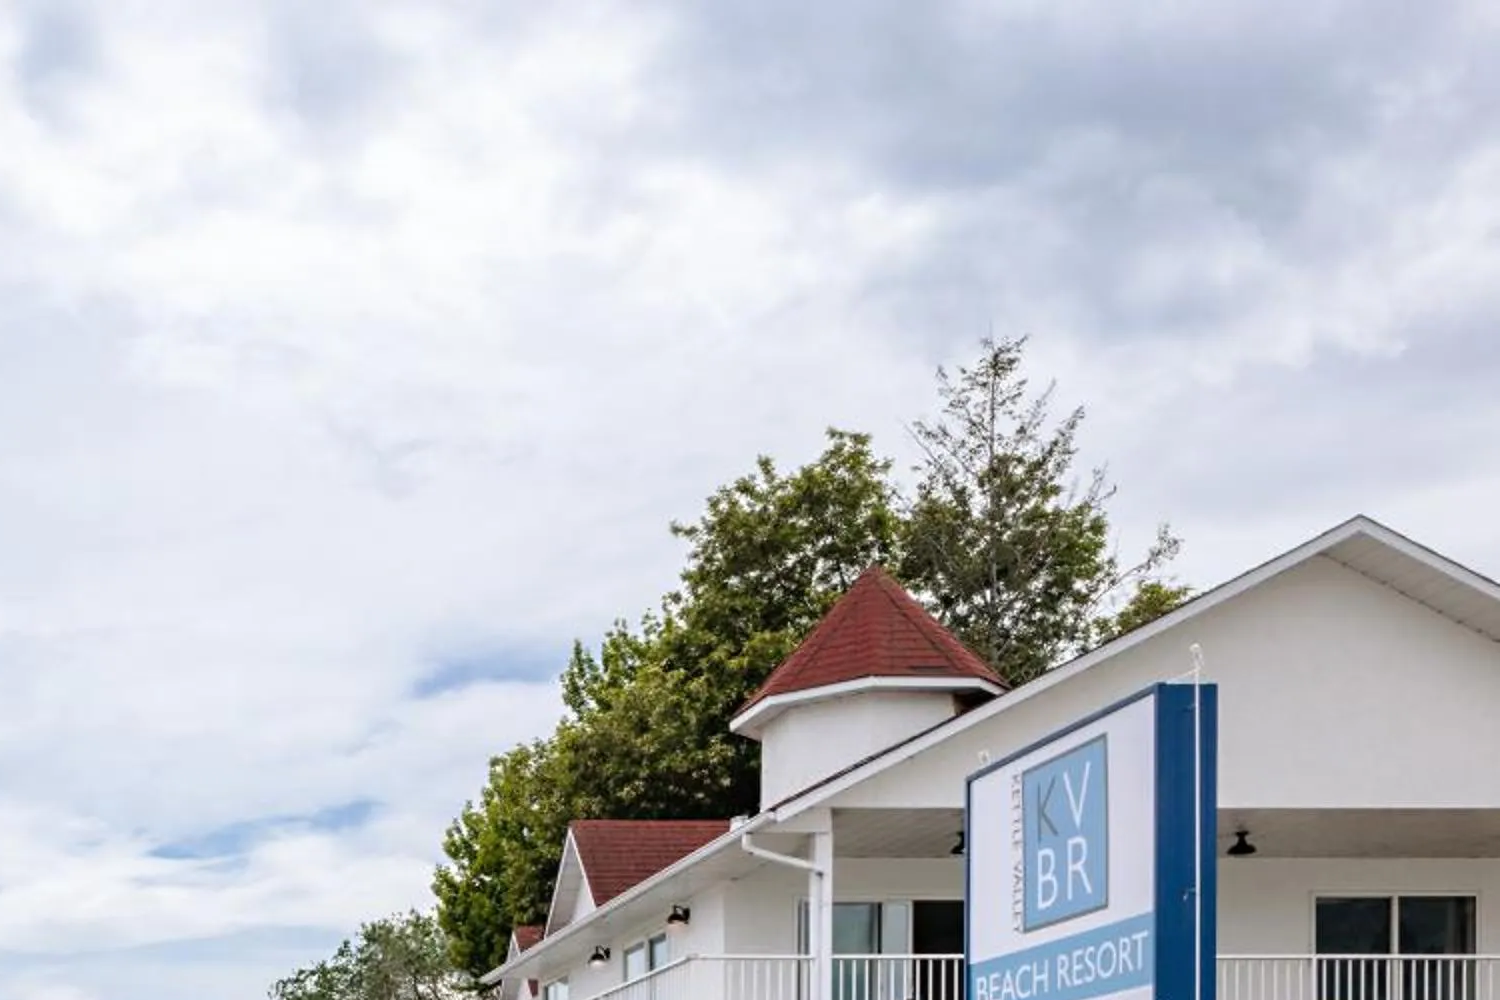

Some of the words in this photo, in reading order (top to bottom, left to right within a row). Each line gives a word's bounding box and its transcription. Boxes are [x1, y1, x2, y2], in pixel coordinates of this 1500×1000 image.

[1037, 761, 1091, 842] KV
[1037, 836, 1092, 911] BR
[1056, 930, 1148, 991] RESORT
